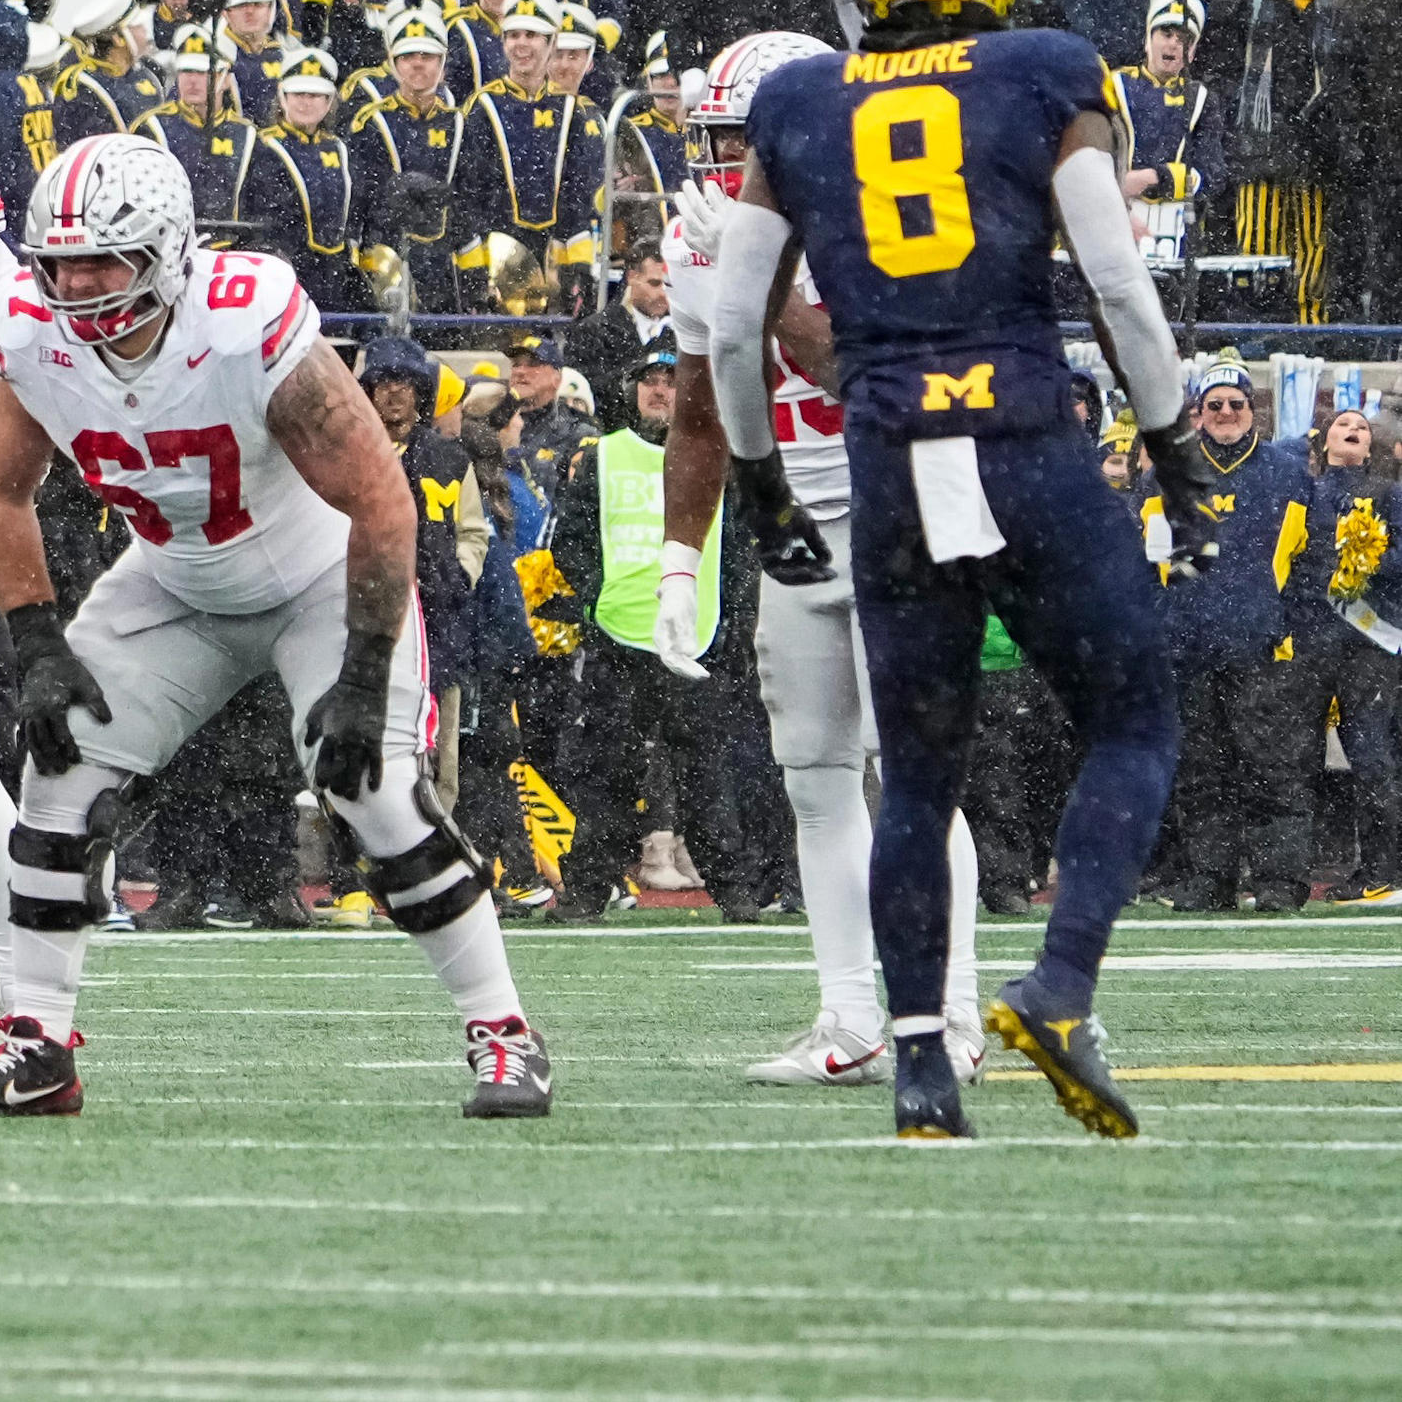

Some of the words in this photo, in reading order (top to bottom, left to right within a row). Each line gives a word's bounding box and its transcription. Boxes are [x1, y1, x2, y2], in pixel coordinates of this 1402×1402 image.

[264, 62, 280, 78] M
[843, 39, 979, 84] MOORE
[19, 76, 45, 105] M
[535, 110, 553, 126] M
[212, 140, 231, 153] M
[428, 129, 447, 147] M
[323, 152, 338, 166] M
[851, 84, 977, 279] 8
[207, 253, 265, 311] 67
[924, 364, 994, 410] M
[71, 424, 254, 547] 67
[420, 477, 463, 524] M
[1212, 494, 1235, 512] M
